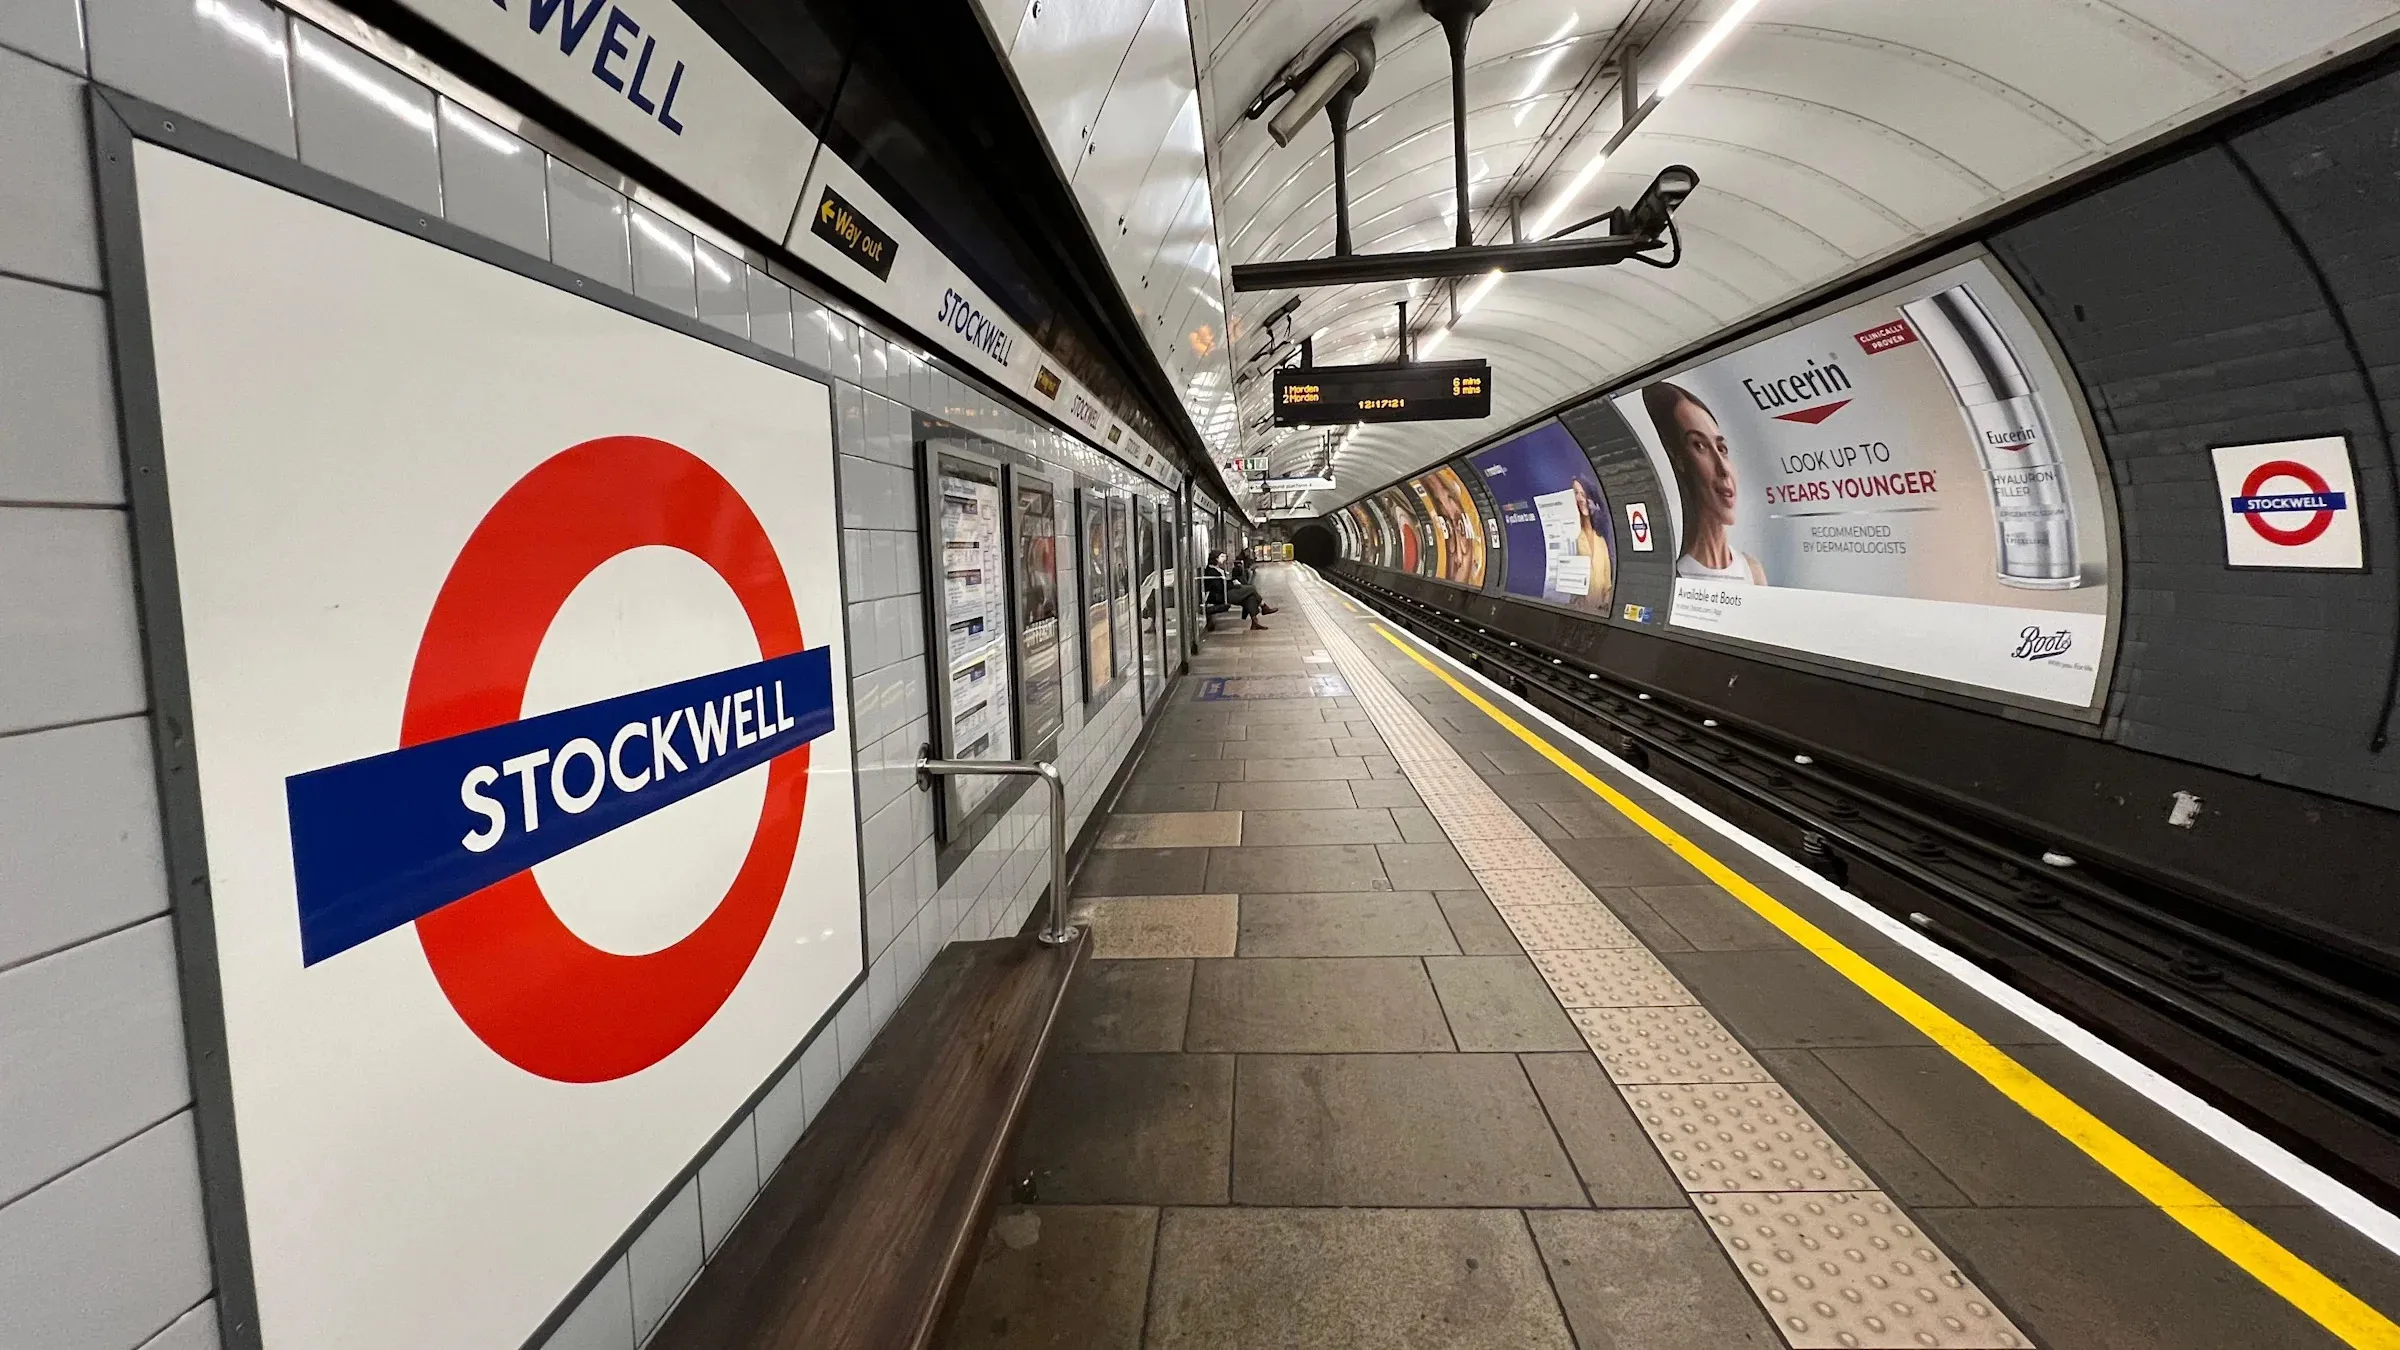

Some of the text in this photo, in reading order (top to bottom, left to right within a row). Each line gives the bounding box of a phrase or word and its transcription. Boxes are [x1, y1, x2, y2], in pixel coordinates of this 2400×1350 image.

[492, 0, 685, 136] WELL
[834, 207, 883, 262] Way out
[937, 287, 1013, 367] STOCKWELL
[1859, 323, 1904, 344] CLINICALLY
[1871, 335, 1905, 350] PROVEN
[1282, 386, 1481, 404] 2 Morden 9 mins
[1289, 385, 1319, 394] Morden
[1453, 378, 1460, 387] 6
[1462, 377, 1481, 386] mins
[1742, 359, 1852, 411] Eucerin
[1358, 399, 1405, 410] 12:17:21
[1986, 427, 2035, 445] Eucerin
[1781, 442, 1890, 474] LOOK UP TO
[1766, 486, 1775, 504] 5
[1776, 481, 1830, 503] YEARS
[1995, 486, 2030, 497] FILLER
[2247, 497, 2327, 510] STOCKWELL
[1811, 525, 1891, 538] RECOMMENDED
[1803, 542, 1907, 554] BY DERMATOLOGISTS
[1678, 586, 1742, 606] Available at Boots
[2011, 625, 2071, 661] Boots
[460, 680, 796, 853] STOCKWELL
